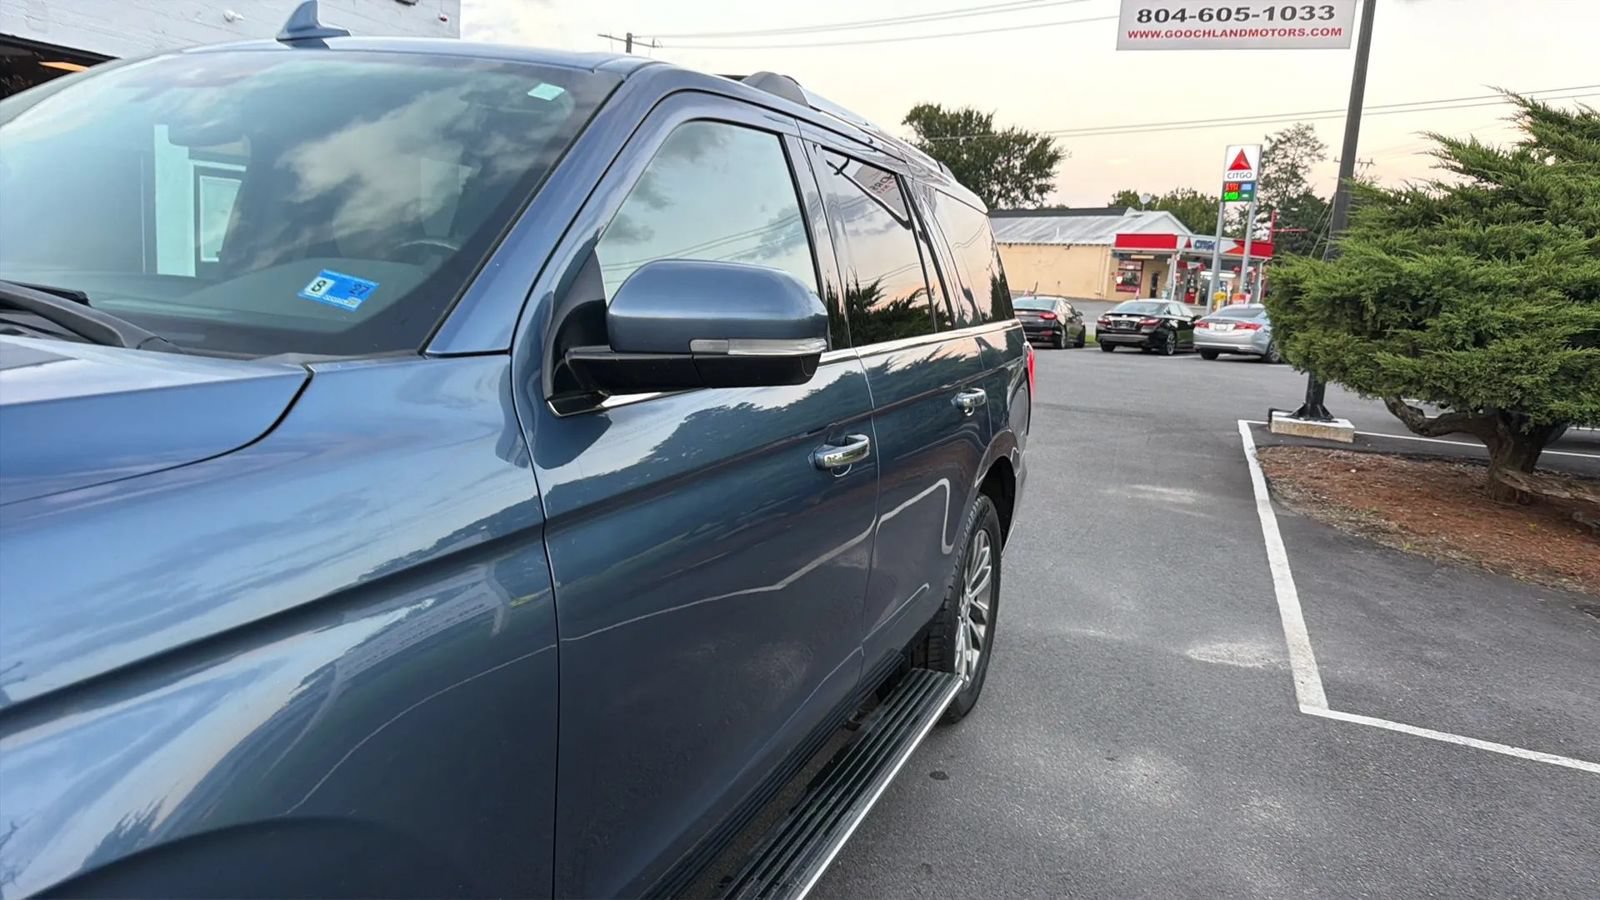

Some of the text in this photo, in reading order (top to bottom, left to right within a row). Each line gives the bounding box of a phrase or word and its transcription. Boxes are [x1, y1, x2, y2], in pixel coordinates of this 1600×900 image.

[1137, 5, 1335, 23] 804-605-1033
[1128, 28, 1342, 39] WWW.GOOCHLANDMOTORS.COM
[311, 280, 326, 292] 8
